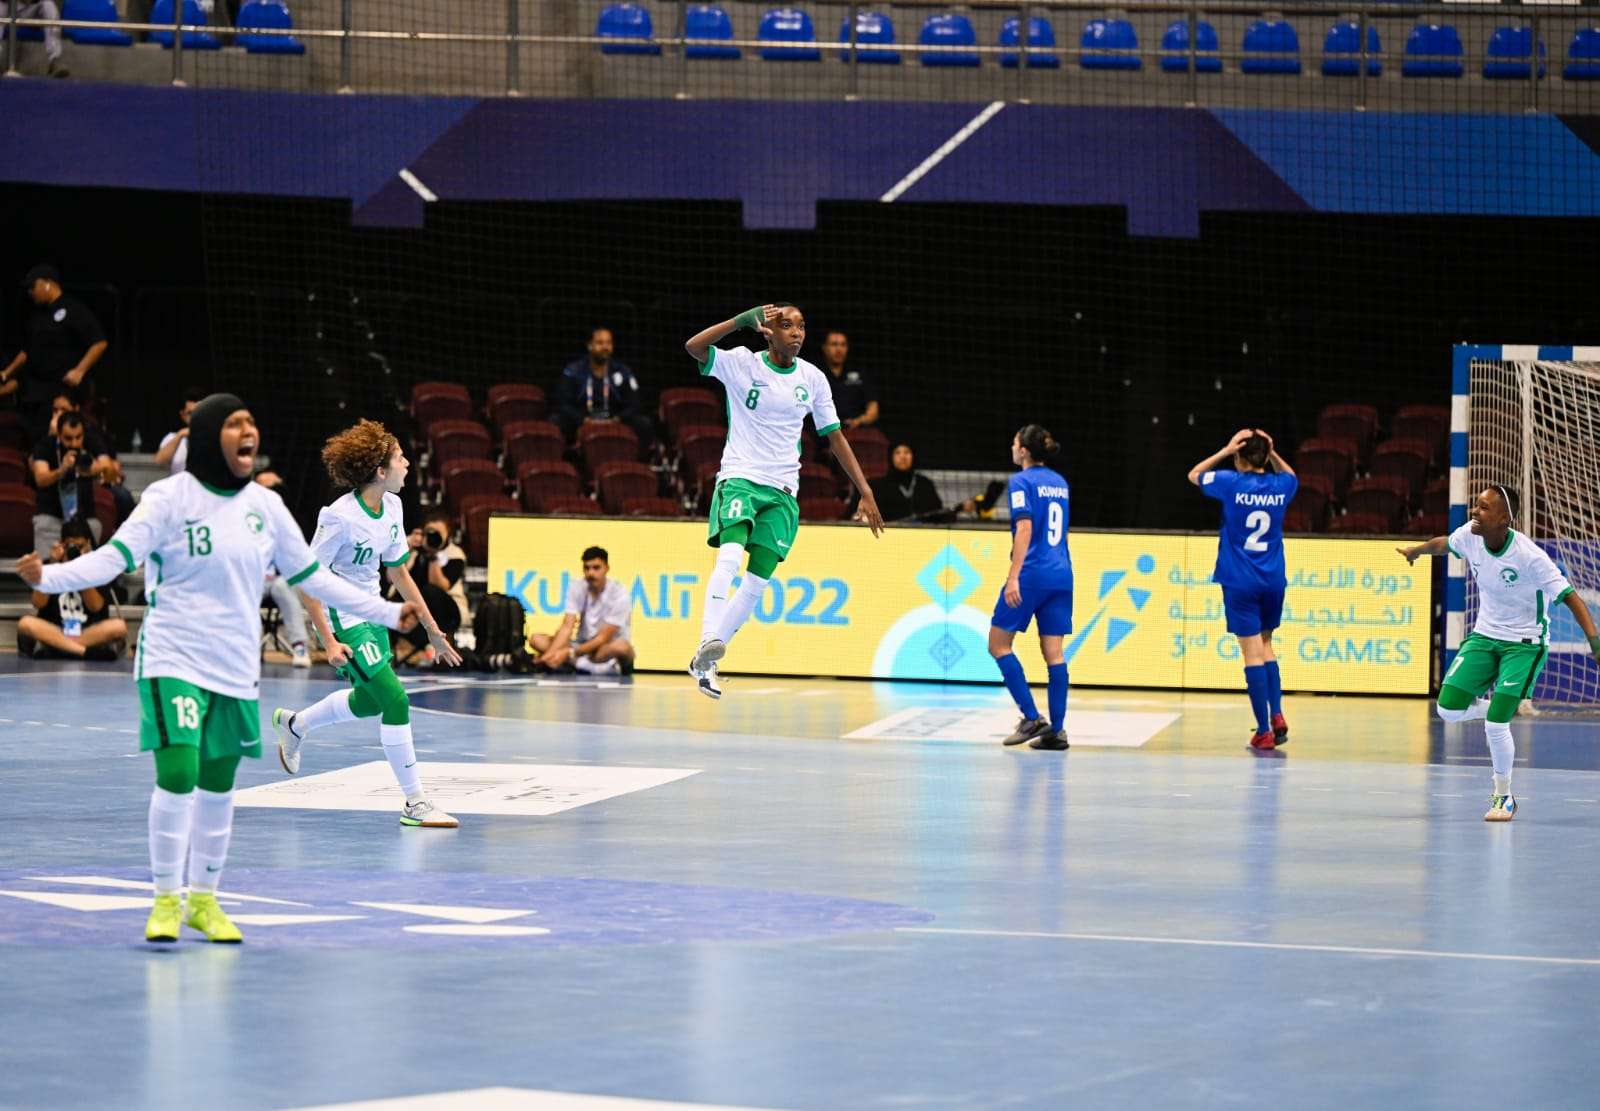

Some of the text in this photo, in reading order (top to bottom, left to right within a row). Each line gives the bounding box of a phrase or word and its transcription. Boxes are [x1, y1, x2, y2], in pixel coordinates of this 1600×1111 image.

[746, 389, 760, 411] 8
[1235, 492, 1286, 506] KUWAIT
[1047, 501, 1063, 547] 9
[1243, 510, 1271, 552] 2
[184, 526, 212, 557] 13
[352, 547, 373, 566] 10
[504, 569, 850, 626] KUAIT 022
[358, 641, 382, 666] 10
[1298, 637, 1412, 664] GAMES
[171, 695, 199, 729] 13
